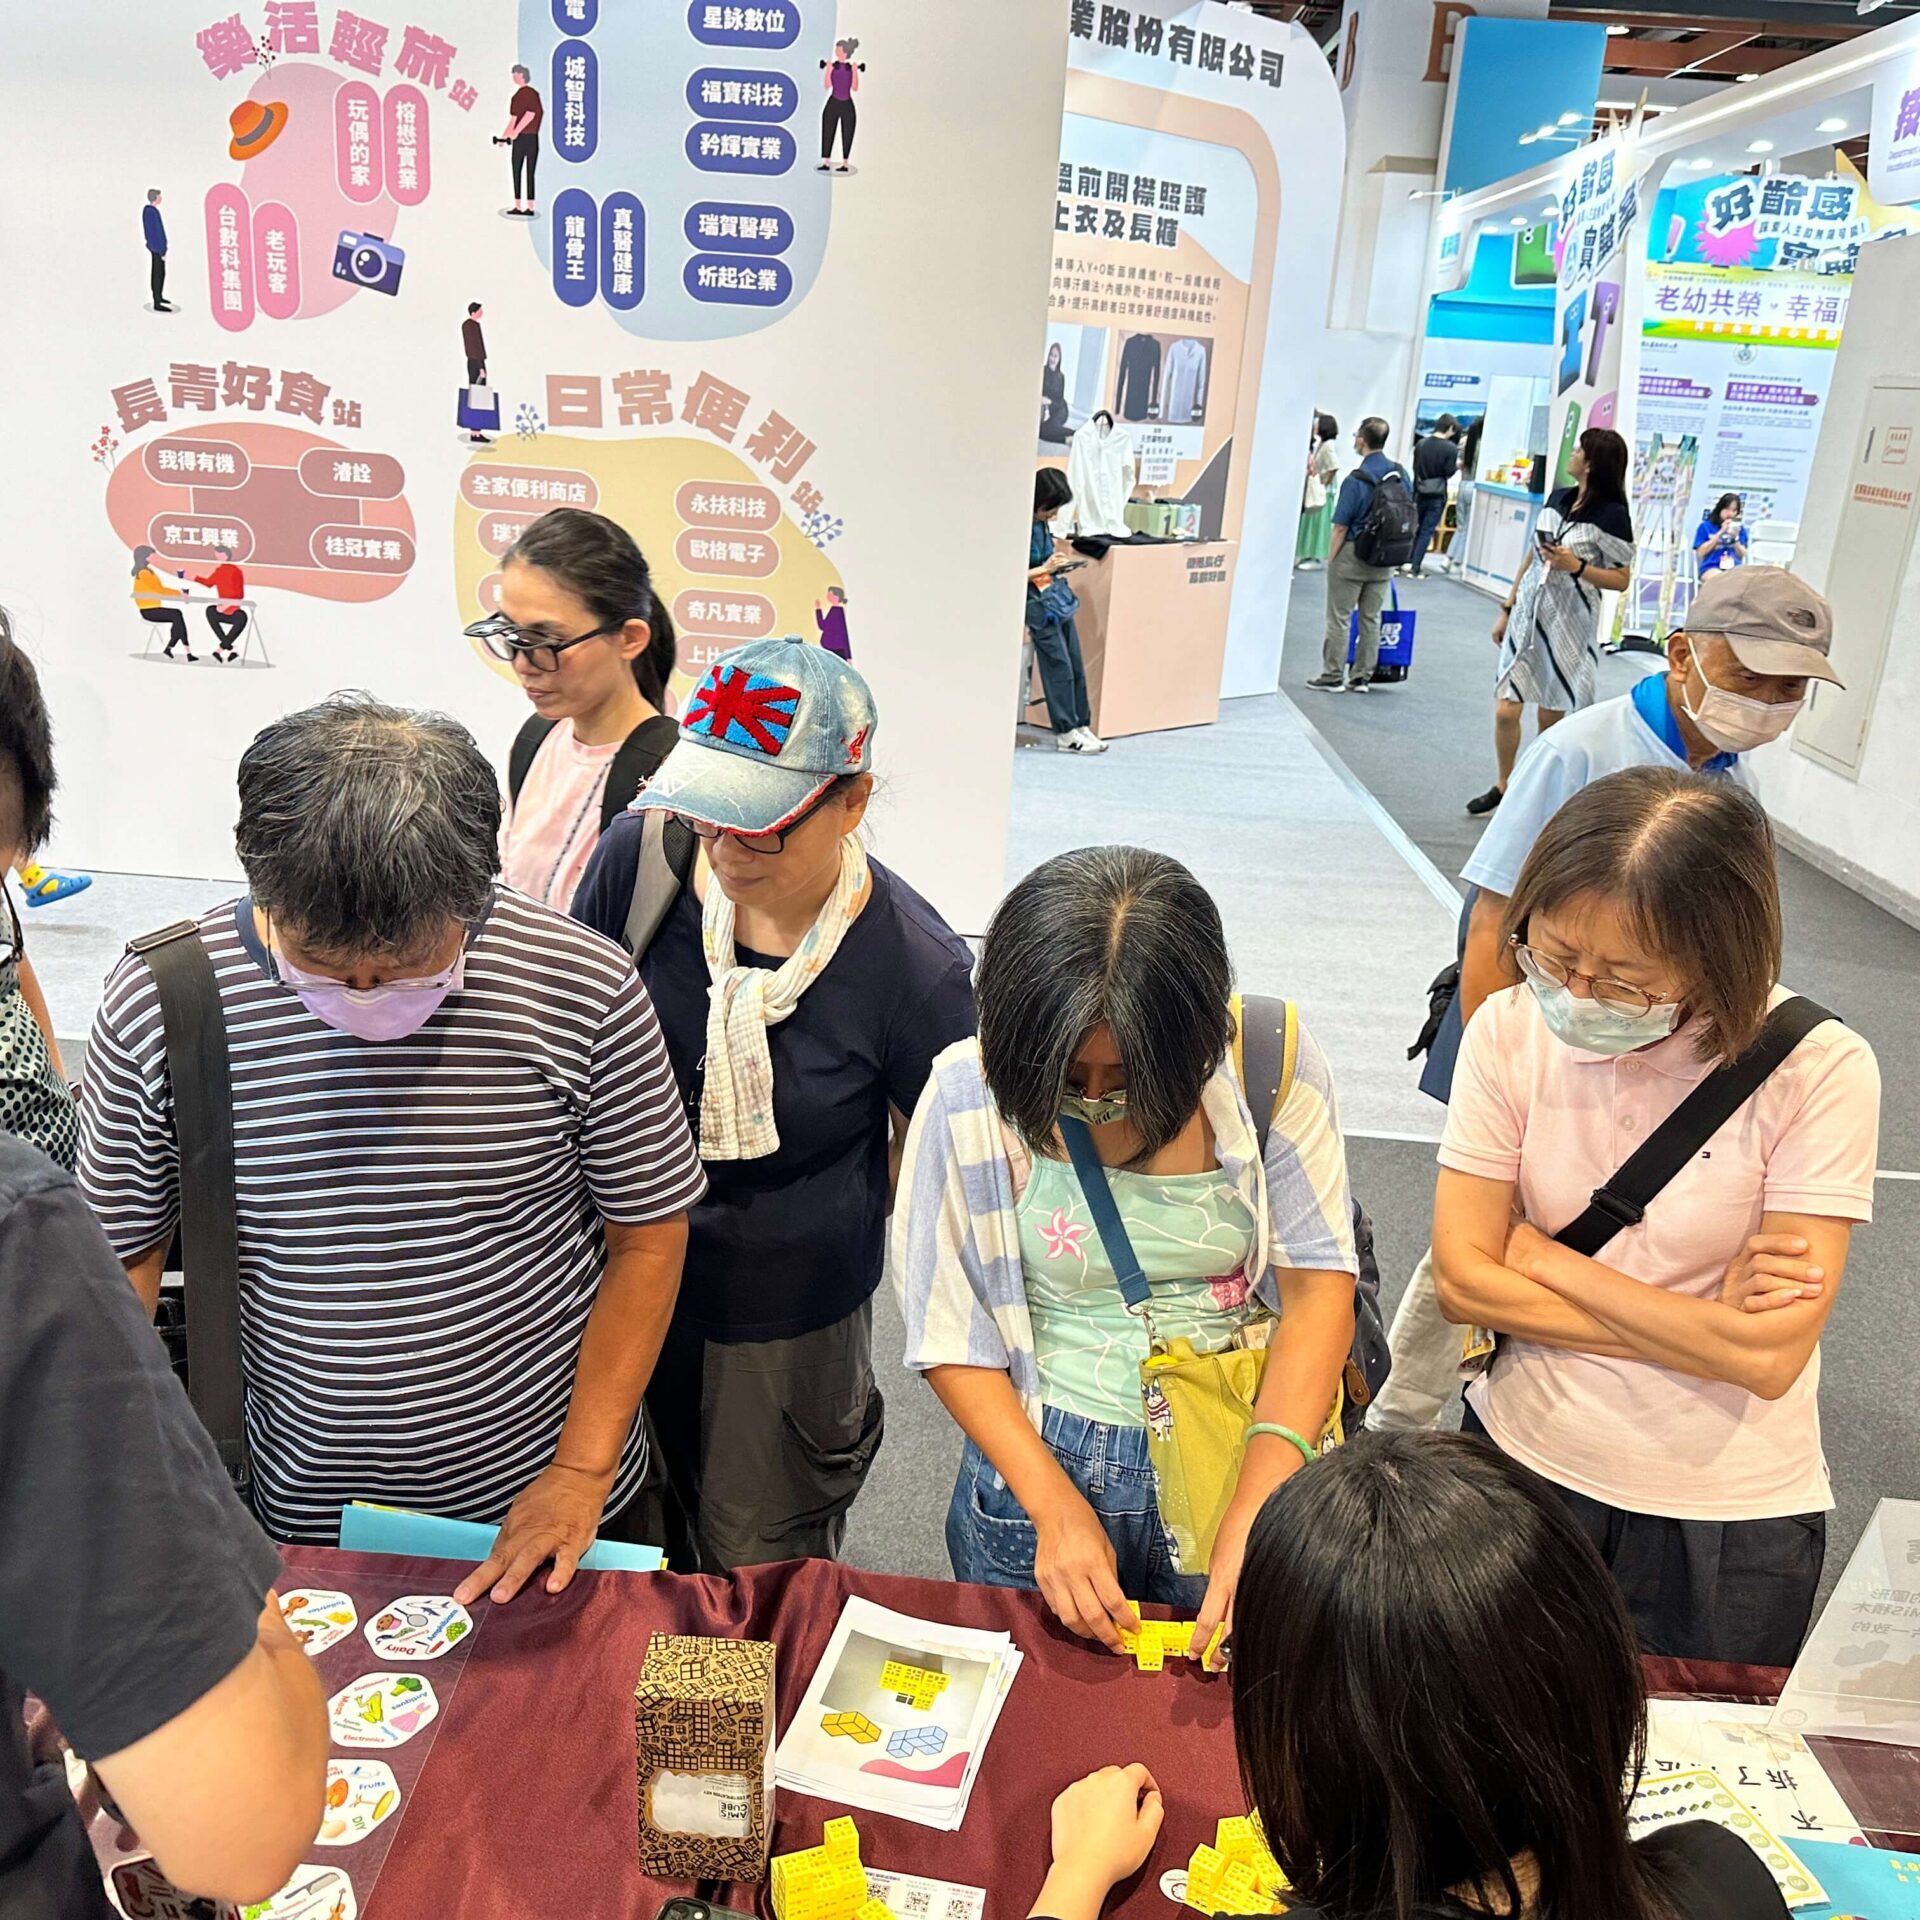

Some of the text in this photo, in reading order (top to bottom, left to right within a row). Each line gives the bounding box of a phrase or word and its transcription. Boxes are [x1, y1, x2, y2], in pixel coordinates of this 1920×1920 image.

[702, 6, 786, 33] 星詠數位
[195, 0, 479, 113] 樂活輕旅站
[1069, 0, 1285, 88] 業股份有限公司
[564, 56, 587, 147] 城智科技
[701, 79, 784, 107] 福寶科技
[347, 98, 371, 188] 玩偶的家
[1710, 179, 1854, 231] 好齡感
[698, 214, 780, 240] 瑞賀醫學
[217, 204, 244, 312] 台數科集團
[265, 230, 288, 294] 老玩客
[564, 216, 586, 280] 龍骨王
[611, 208, 633, 294] 真醫健康
[1655, 285, 1850, 325] 老幼共榮 幸福
[110, 360, 362, 434] 長青好食站
[545, 369, 824, 516] 日常便利站
[158, 449, 235, 475] 我得有機
[472, 476, 587, 504] 全家便利商店
[690, 493, 767, 519] 永扶科技
[324, 535, 403, 561] 桂冠實業
[689, 538, 766, 564] 歐格電子
[687, 599, 762, 625] 奇凡實業
[384, 1644, 417, 1656] Dairy
[391, 1691, 428, 1711] Antiques
[359, 1780, 387, 1791] Fruits
[720, 1801, 748, 1812] CUBE
[352, 1815, 368, 1830] DIY
